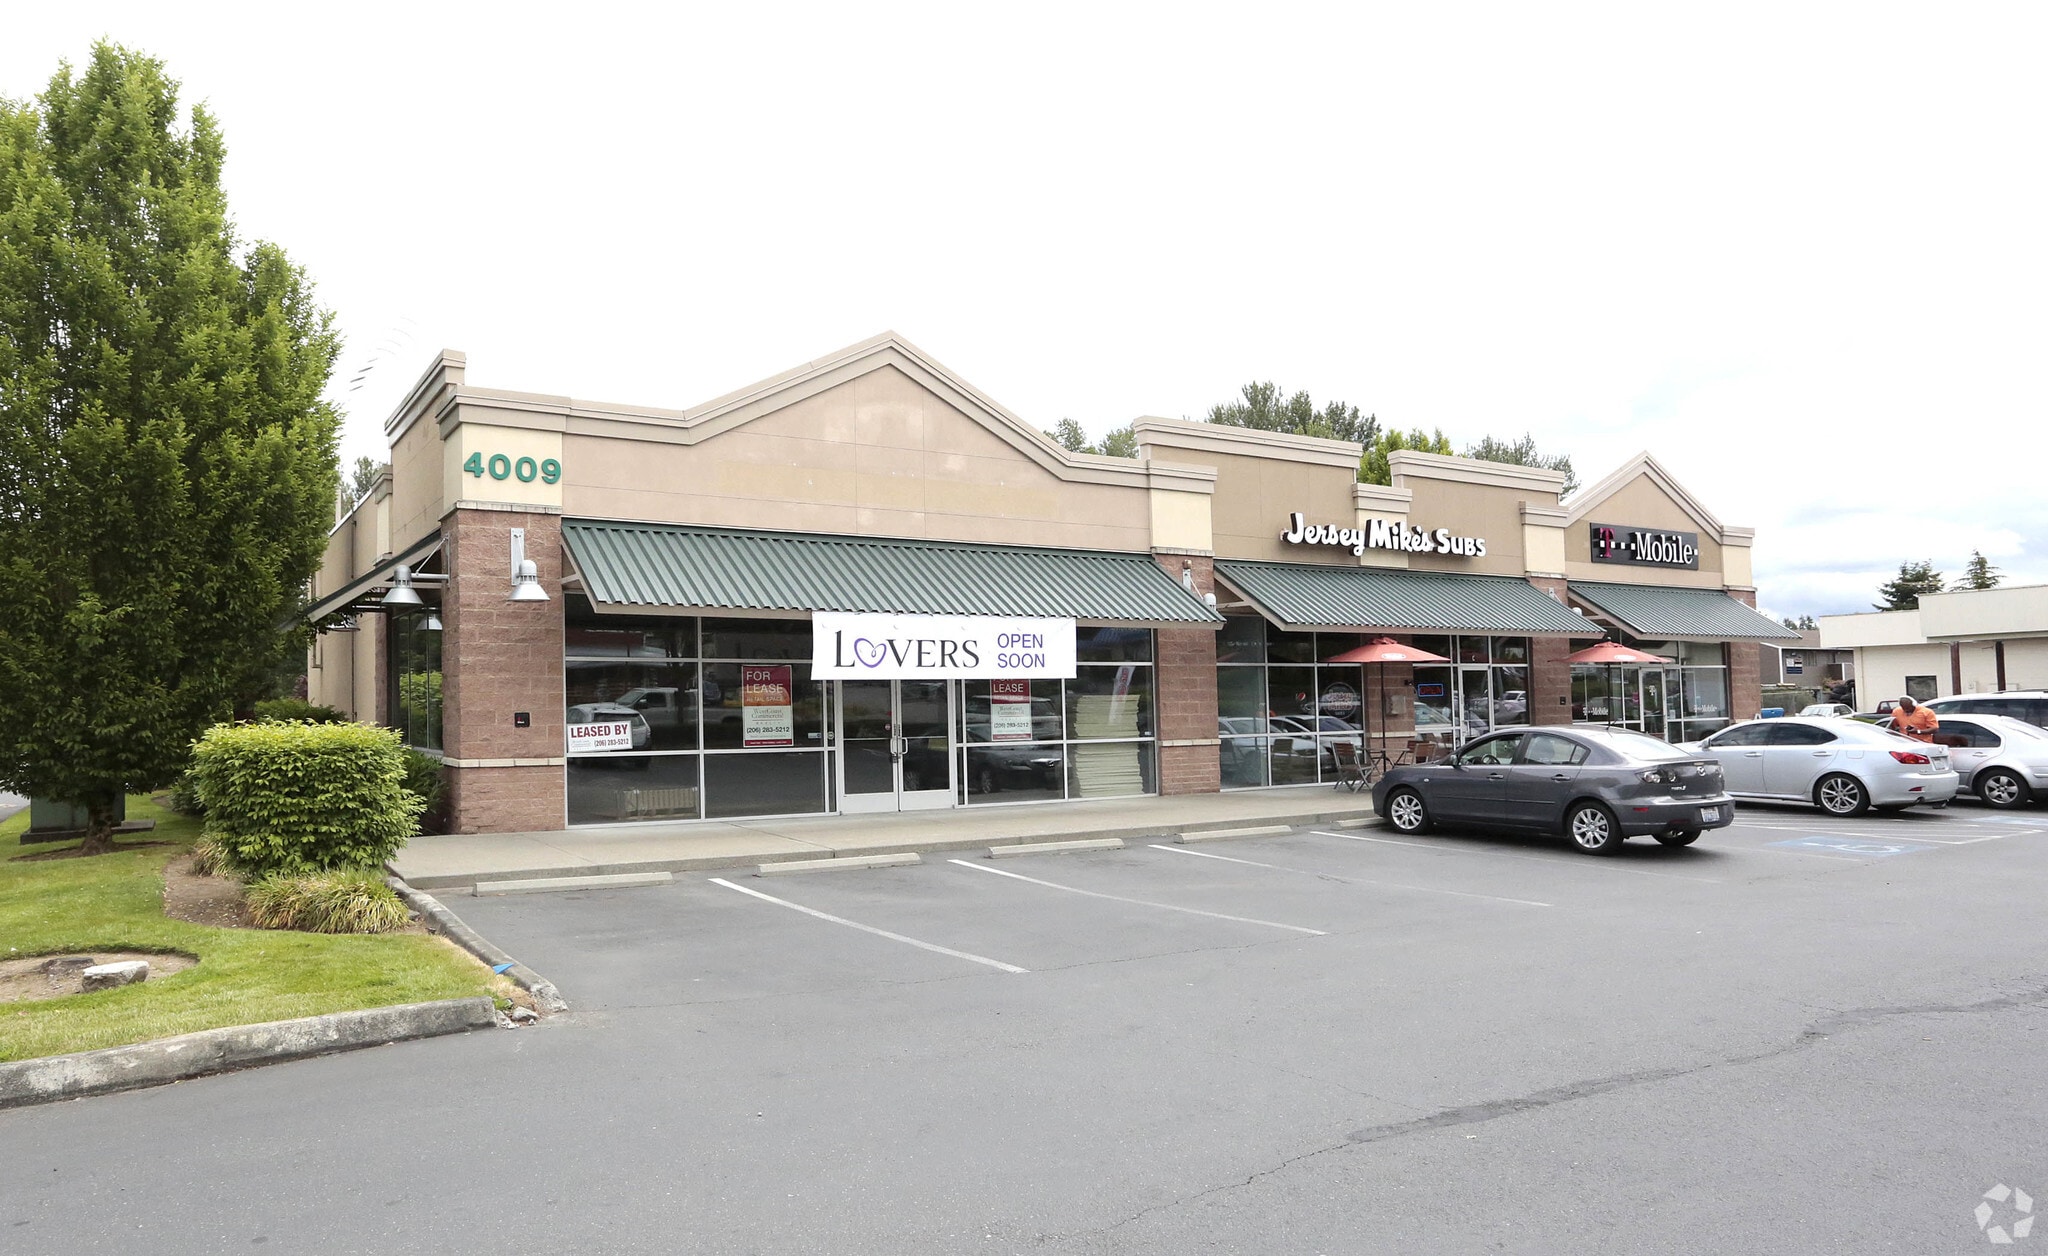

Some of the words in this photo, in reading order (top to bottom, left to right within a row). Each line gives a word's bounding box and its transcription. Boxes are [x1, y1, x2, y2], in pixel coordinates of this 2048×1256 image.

[463, 451, 562, 485] 4009
[1287, 512, 1366, 557] Jersey
[1366, 518, 1435, 553] Mike's
[996, 633, 1044, 649] OPEN
[833, 629, 980, 669] LOVERS
[996, 652, 1046, 669] SOON
[746, 671, 771, 681] FOR
[746, 683, 784, 694] LEASE
[993, 683, 1024, 693] LEASE
[571, 725, 611, 738] LEASED
[614, 724, 628, 736] BY
[746, 726, 761, 734] (206)
